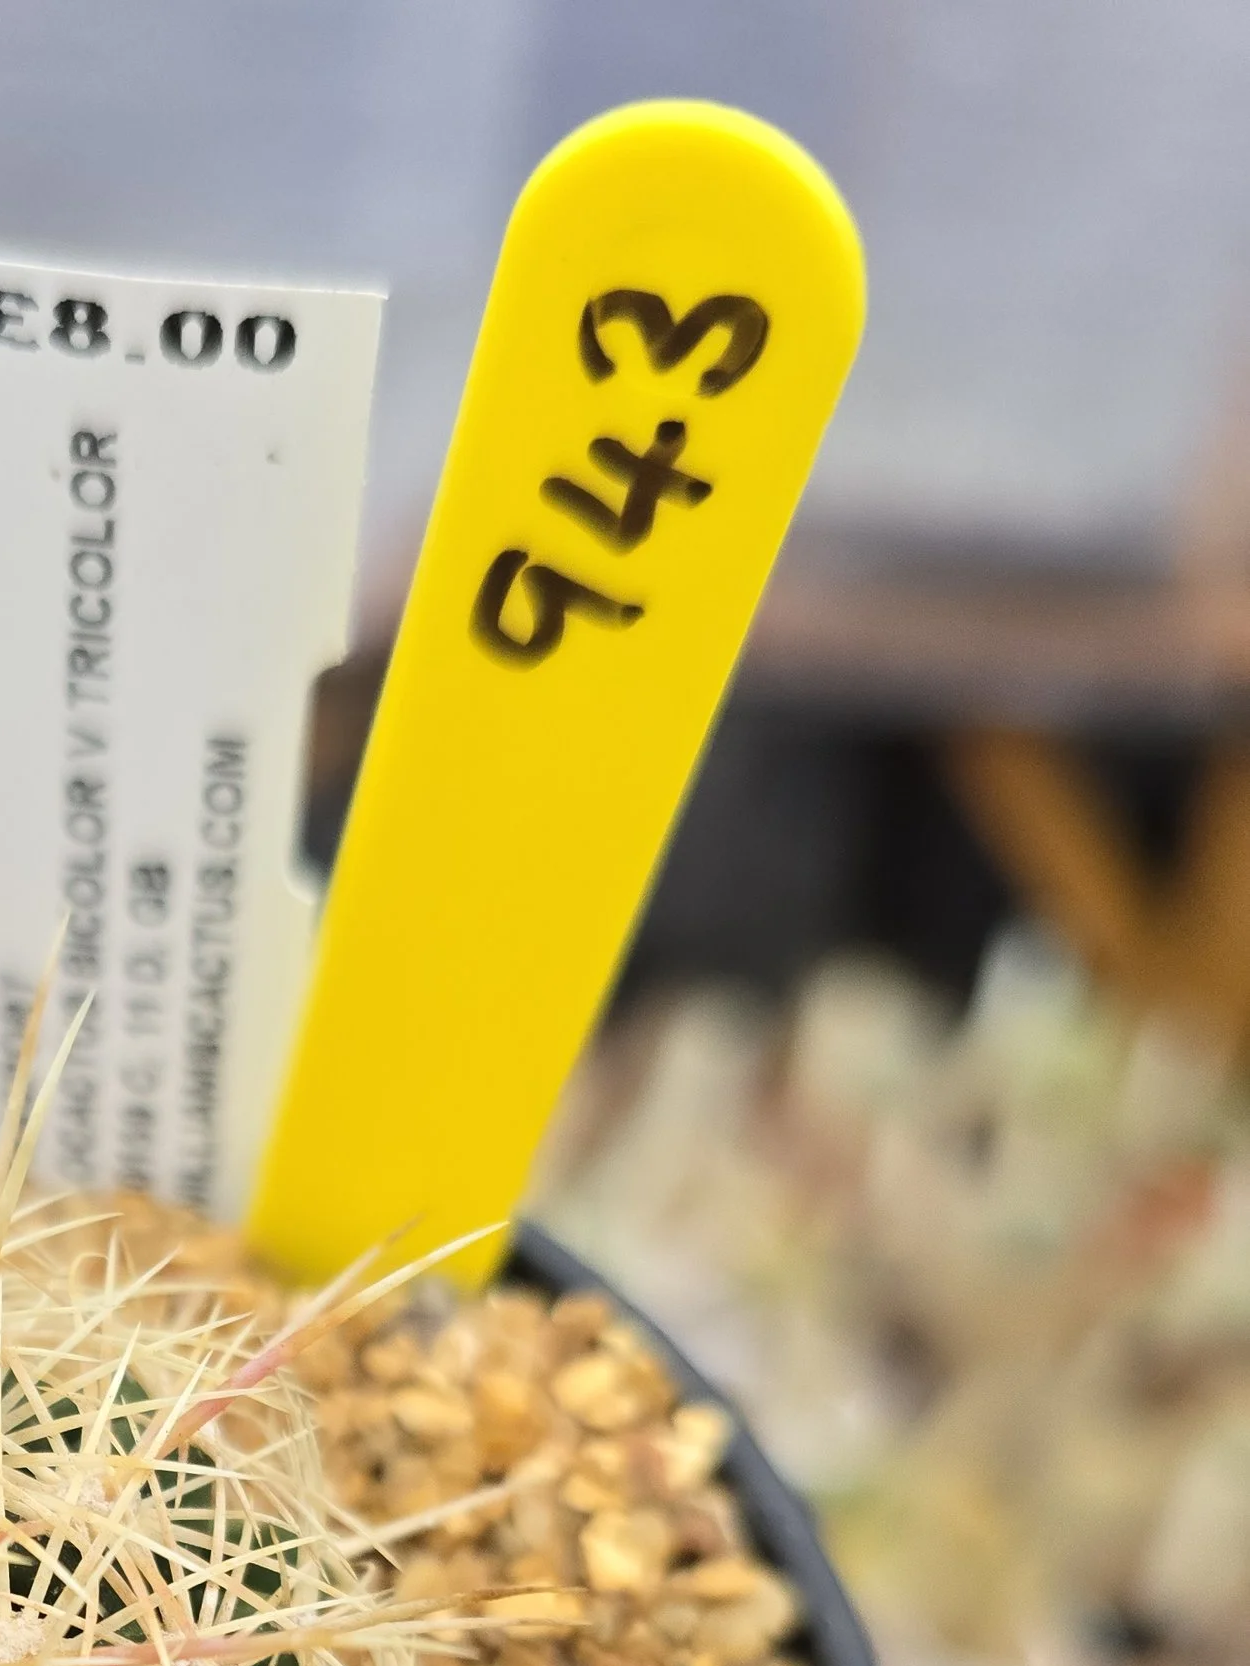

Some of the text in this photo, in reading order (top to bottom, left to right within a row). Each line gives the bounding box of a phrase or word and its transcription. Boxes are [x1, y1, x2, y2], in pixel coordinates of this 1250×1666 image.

[67, 429, 118, 711] TRICOLOR
[468, 288, 771, 674] 943
[64, 775, 107, 979] BICOLOR
